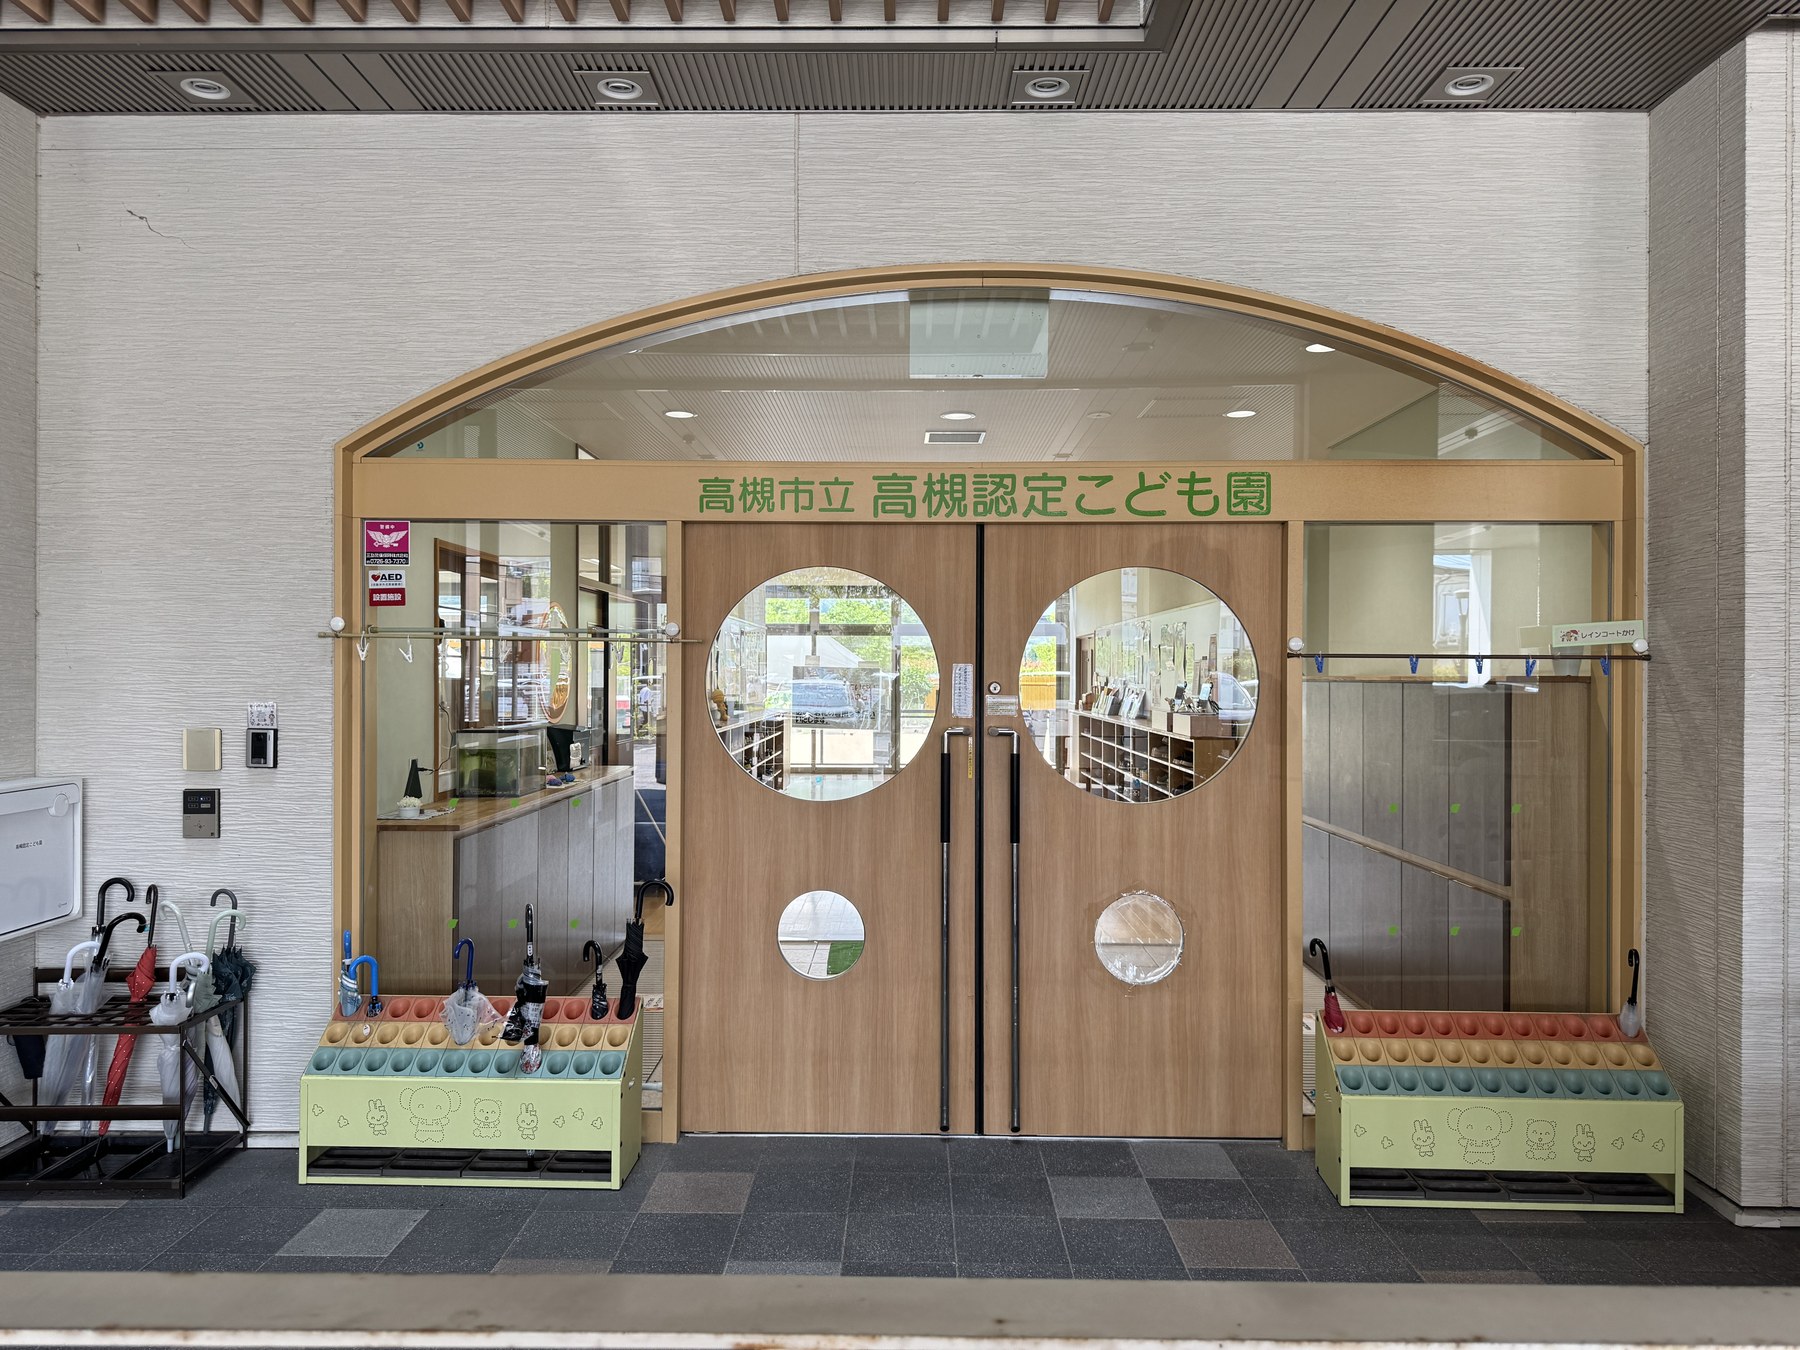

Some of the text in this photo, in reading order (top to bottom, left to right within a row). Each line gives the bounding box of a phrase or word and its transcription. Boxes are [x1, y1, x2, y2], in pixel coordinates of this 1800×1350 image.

[698, 470, 1271, 519] 高槻市立 高槻認定こども園
[373, 593, 402, 601] 設置施設
[1581, 629, 1635, 639] レインコートかけ
